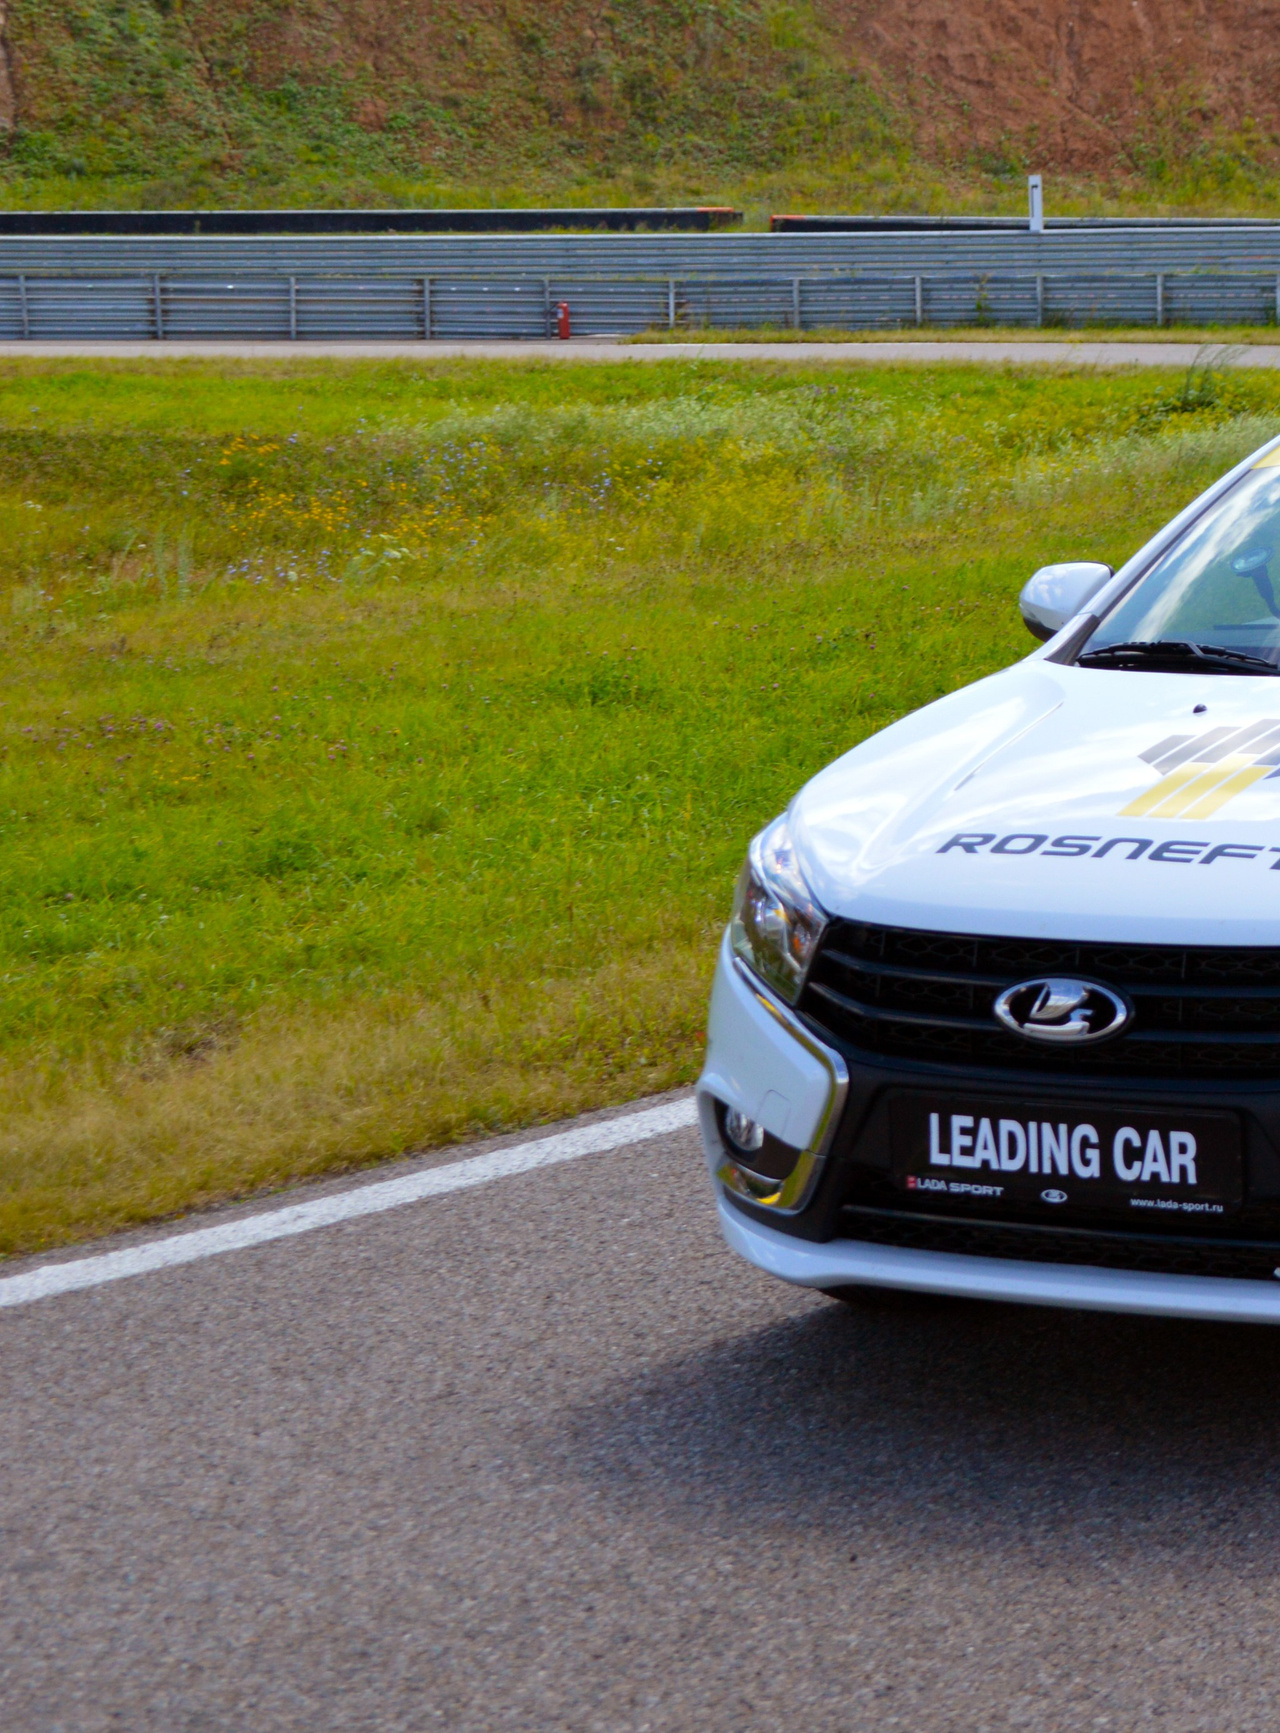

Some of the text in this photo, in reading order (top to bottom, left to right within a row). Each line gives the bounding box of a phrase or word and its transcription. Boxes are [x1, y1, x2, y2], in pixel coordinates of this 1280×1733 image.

[929, 1112, 1198, 1185] LEADING CAR
[917, 1178, 1004, 1196] LADA SPORT
[1130, 1198, 1224, 1213] www.lada-sport.ru
